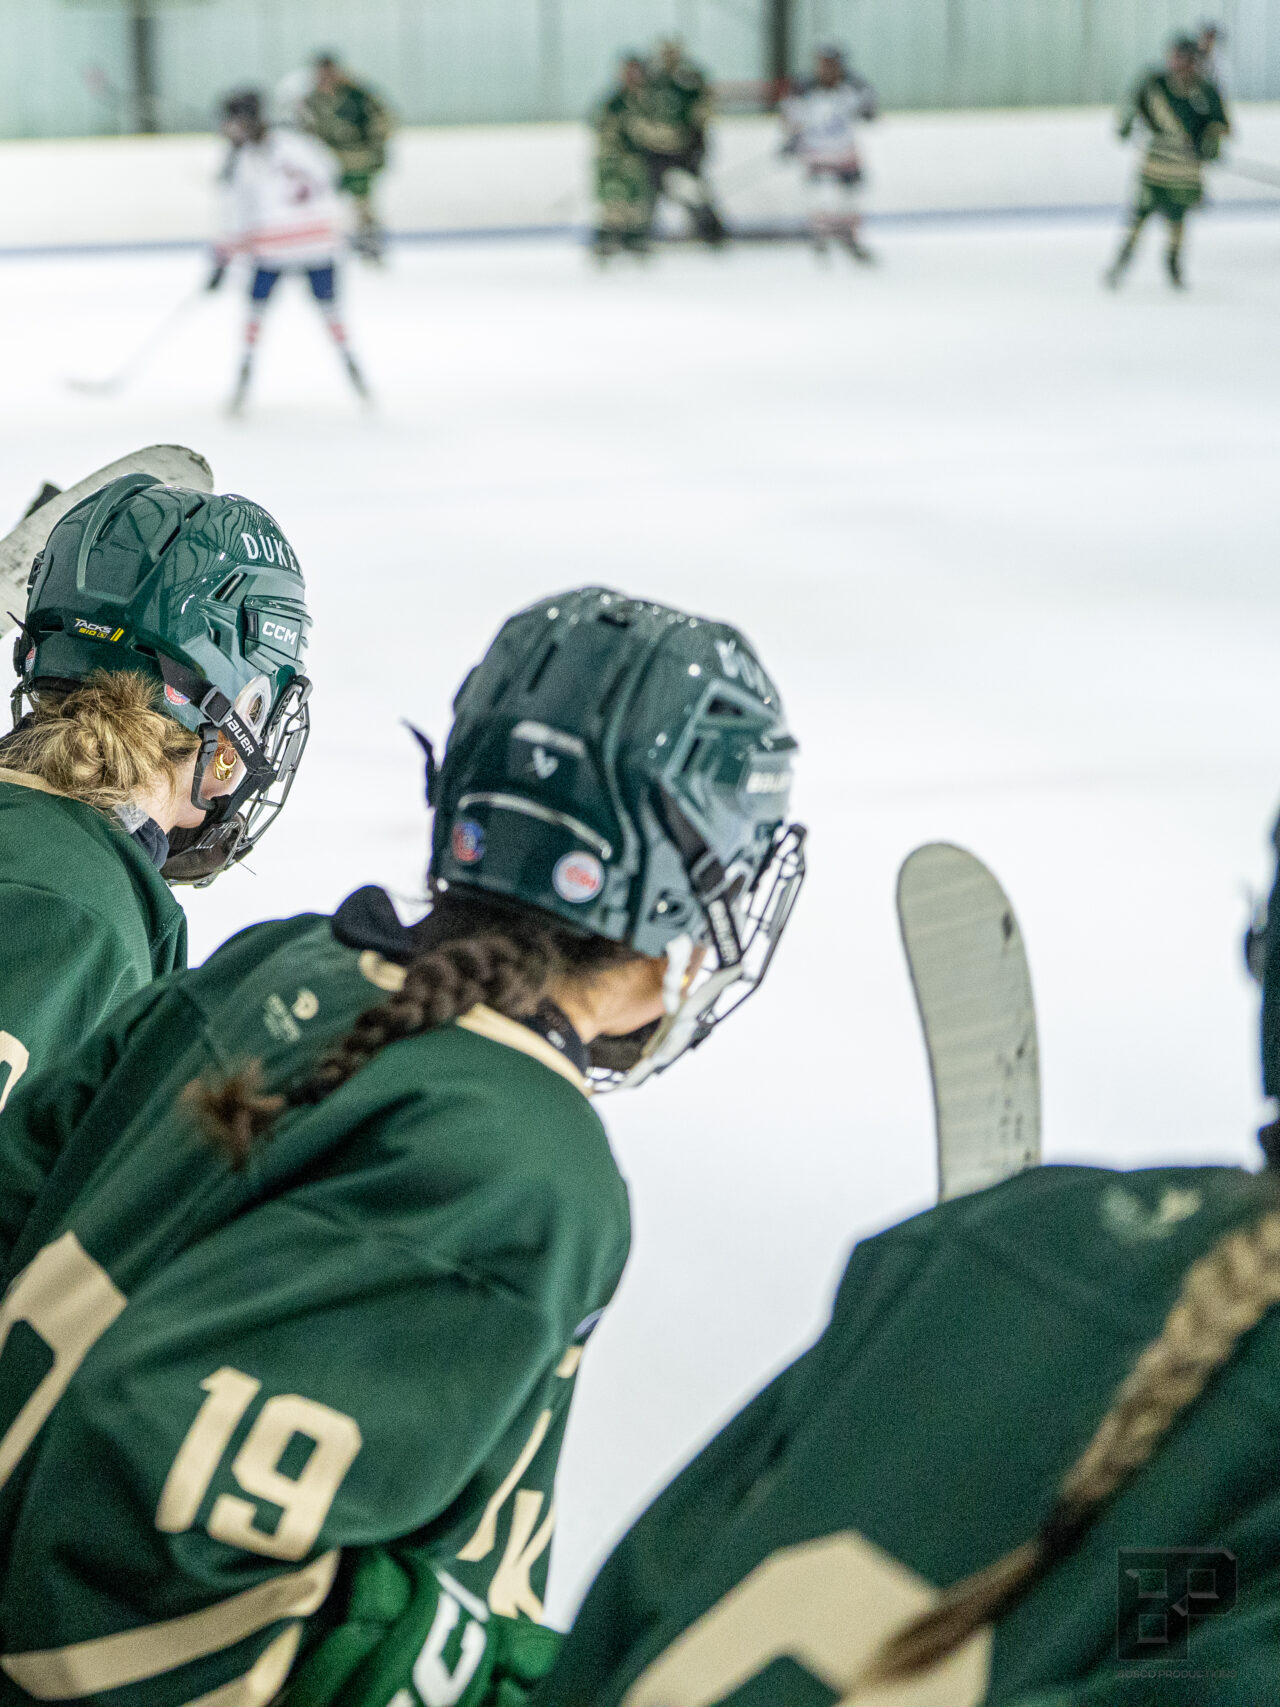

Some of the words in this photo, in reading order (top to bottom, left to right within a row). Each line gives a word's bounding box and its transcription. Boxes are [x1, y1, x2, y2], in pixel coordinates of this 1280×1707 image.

[74, 618, 112, 634] TACKS
[261, 621, 298, 645] CCM
[154, 1366, 362, 1562] 19
